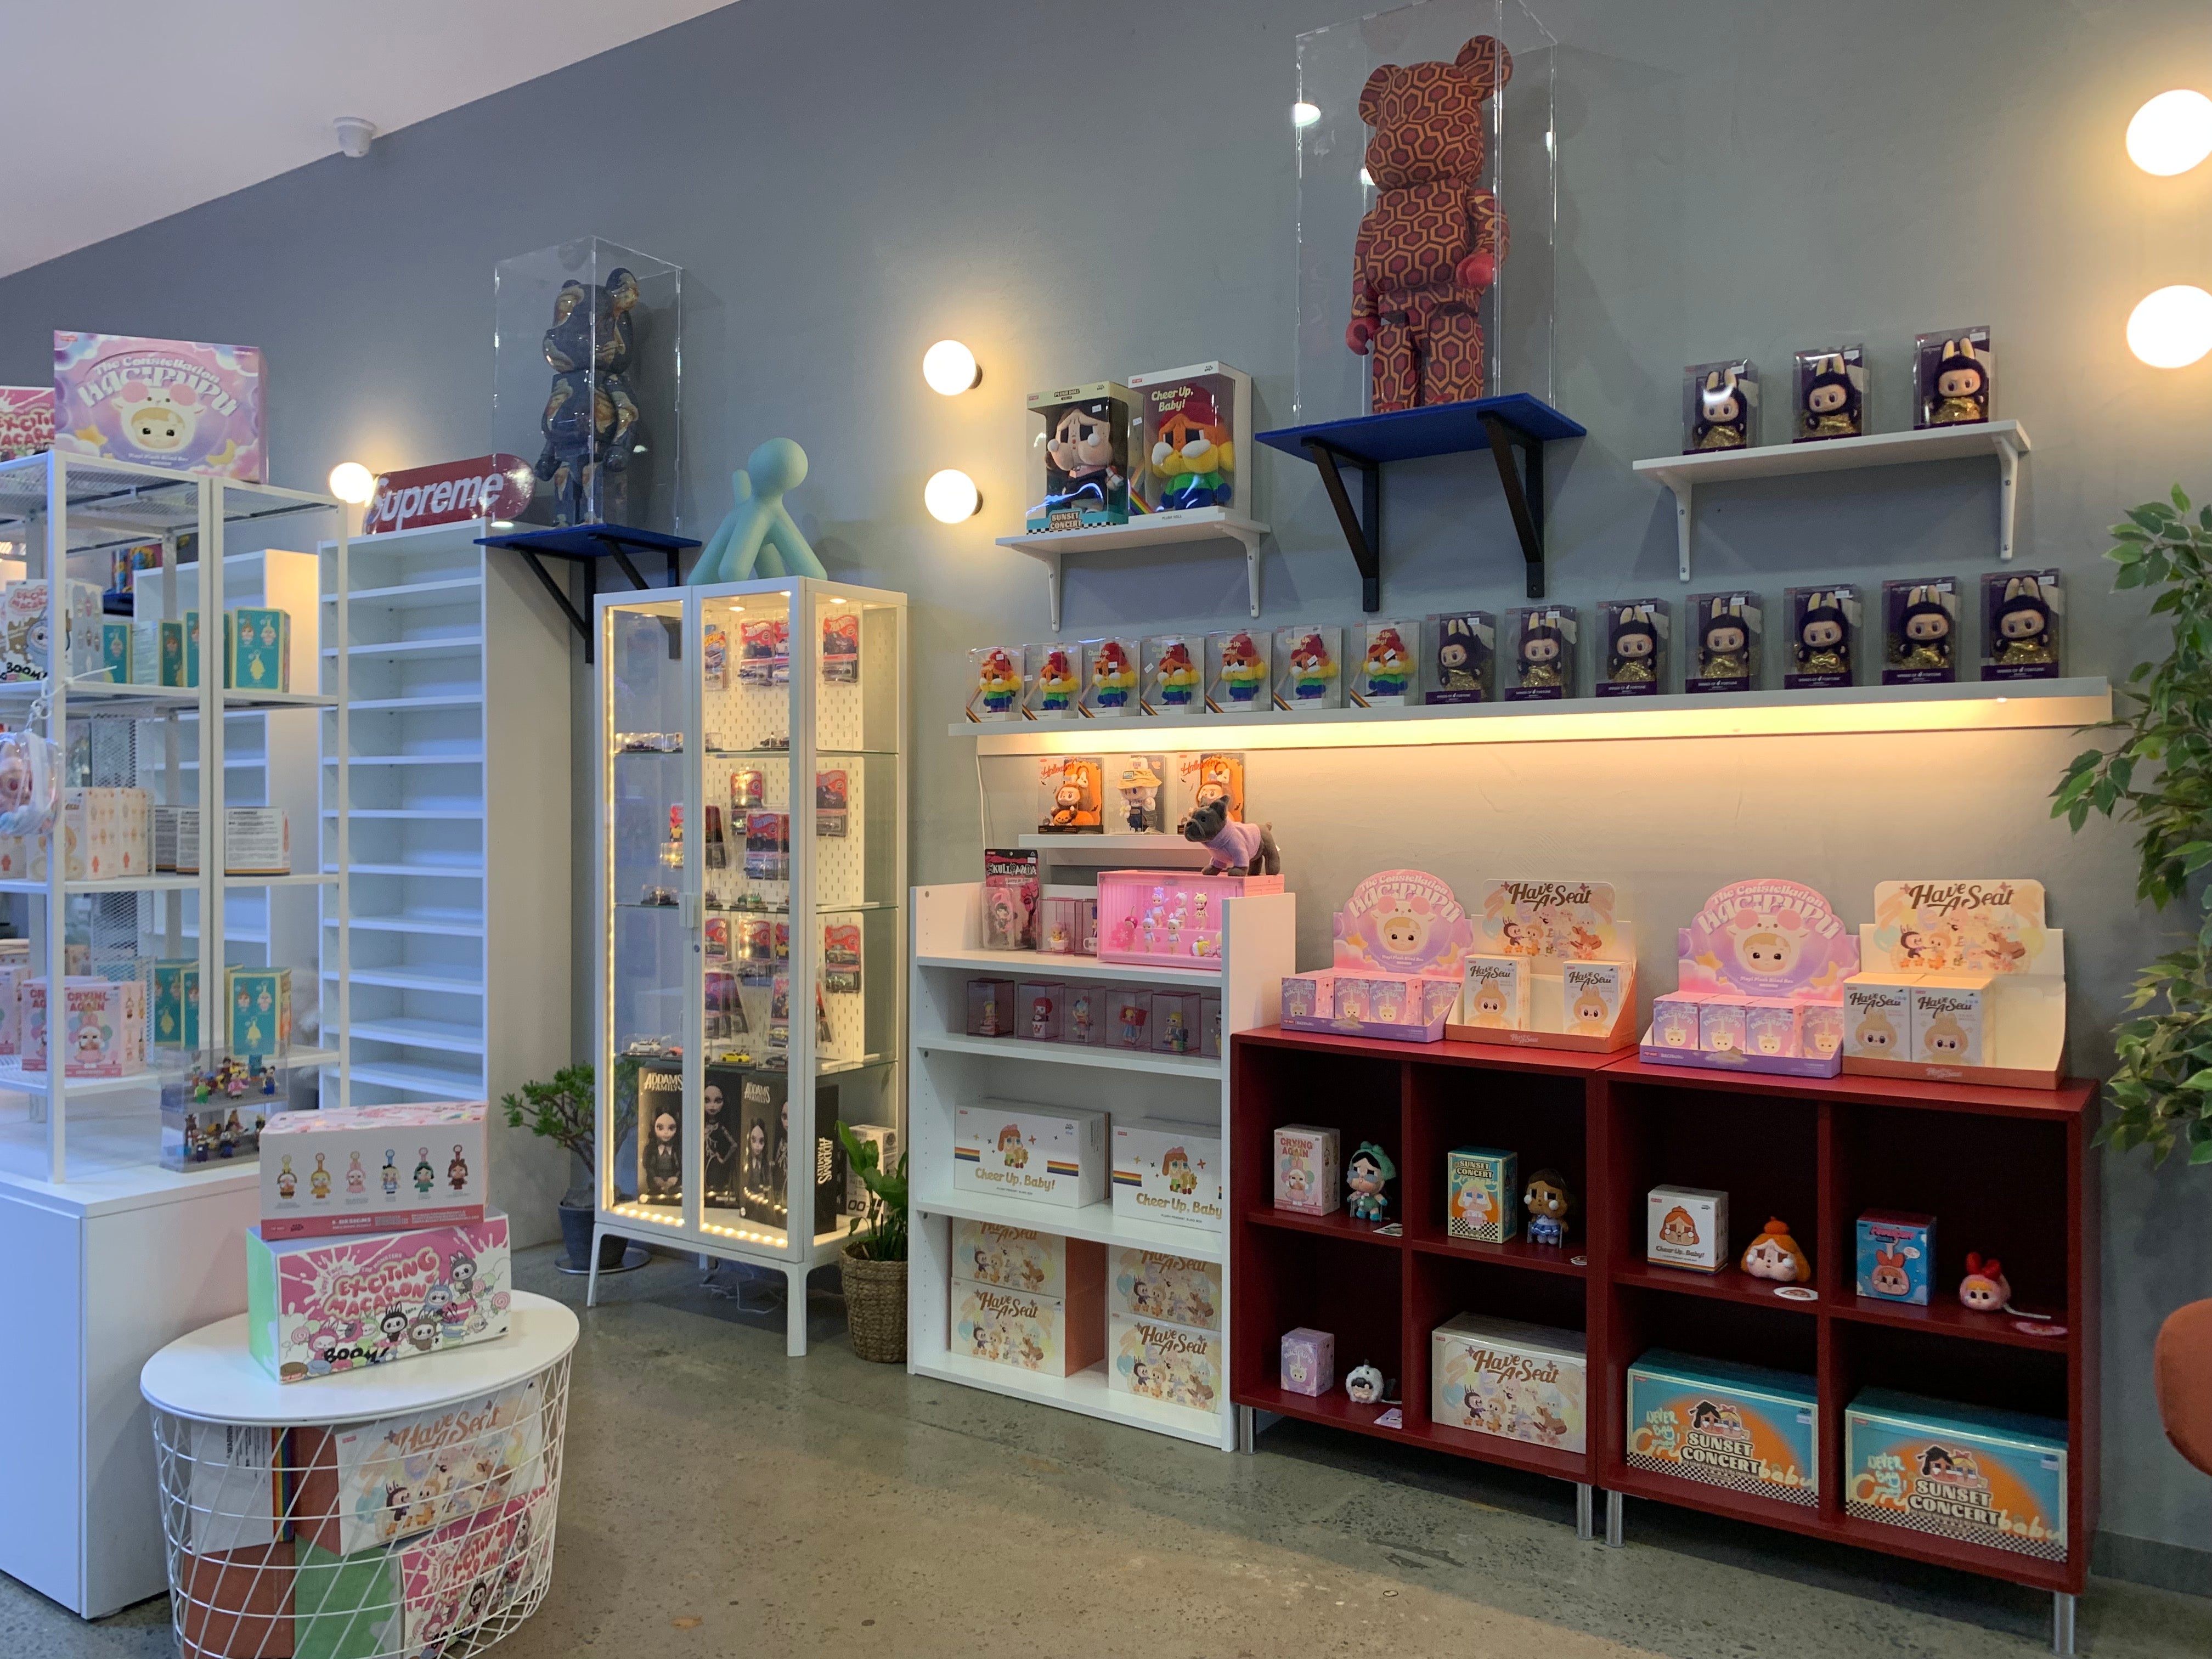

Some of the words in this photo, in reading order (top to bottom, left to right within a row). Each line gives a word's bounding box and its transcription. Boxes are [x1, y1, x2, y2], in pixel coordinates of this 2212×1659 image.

[1152, 390, 1178, 401] Cheer
[1178, 386, 1194, 398] Up,
[1158, 398, 1186, 412] Baby!
[1049, 519, 1082, 530] CONCERT
[1051, 511, 1080, 522] SUNSET
[987, 862, 1037, 876] SKULLPANDA
[1359, 879, 1378, 892] The
[1380, 875, 1448, 894] Constellation
[1509, 883, 1555, 905] Have
[1549, 885, 1592, 906] Seat
[1711, 890, 1735, 905] The
[1737, 885, 1825, 907] Constellation
[1909, 883, 1966, 909] Have
[1961, 885, 2015, 910] Seat
[1470, 966, 1493, 978] Have
[1569, 971, 1594, 984] Have
[1849, 992, 1878, 1006] Have
[1917, 995, 1948, 1010] Have
[644, 1073, 683, 1091] ADDAMS
[744, 1082, 770, 1104] ADDAMS
[1280, 1137, 1313, 1150] CRYING
[817, 1137, 833, 1184] ADDAMS
[1459, 1159, 1491, 1170] SUNSET
[975, 1167, 1005, 1182] Cheer
[1024, 1175, 1056, 1192] Baby!
[1456, 1167, 1494, 1179] CONCERT
[1136, 1192, 1171, 1209] Cheer
[328, 1284, 427, 1318] MACARON
[979, 1291, 1012, 1311] Have
[1008, 1299, 1039, 1318] Seat
[1140, 1325, 1177, 1345] Have
[1172, 1334, 1208, 1355] Seat
[1472, 1350, 1521, 1373] Have
[1515, 1359, 1560, 1384] Seat
[1686, 1431, 1754, 1457] SUNSET
[1680, 1446, 1761, 1475] CONCERT
[1915, 1479, 1993, 1508] SUNSET
[1908, 1494, 2000, 1526] CONCERT
